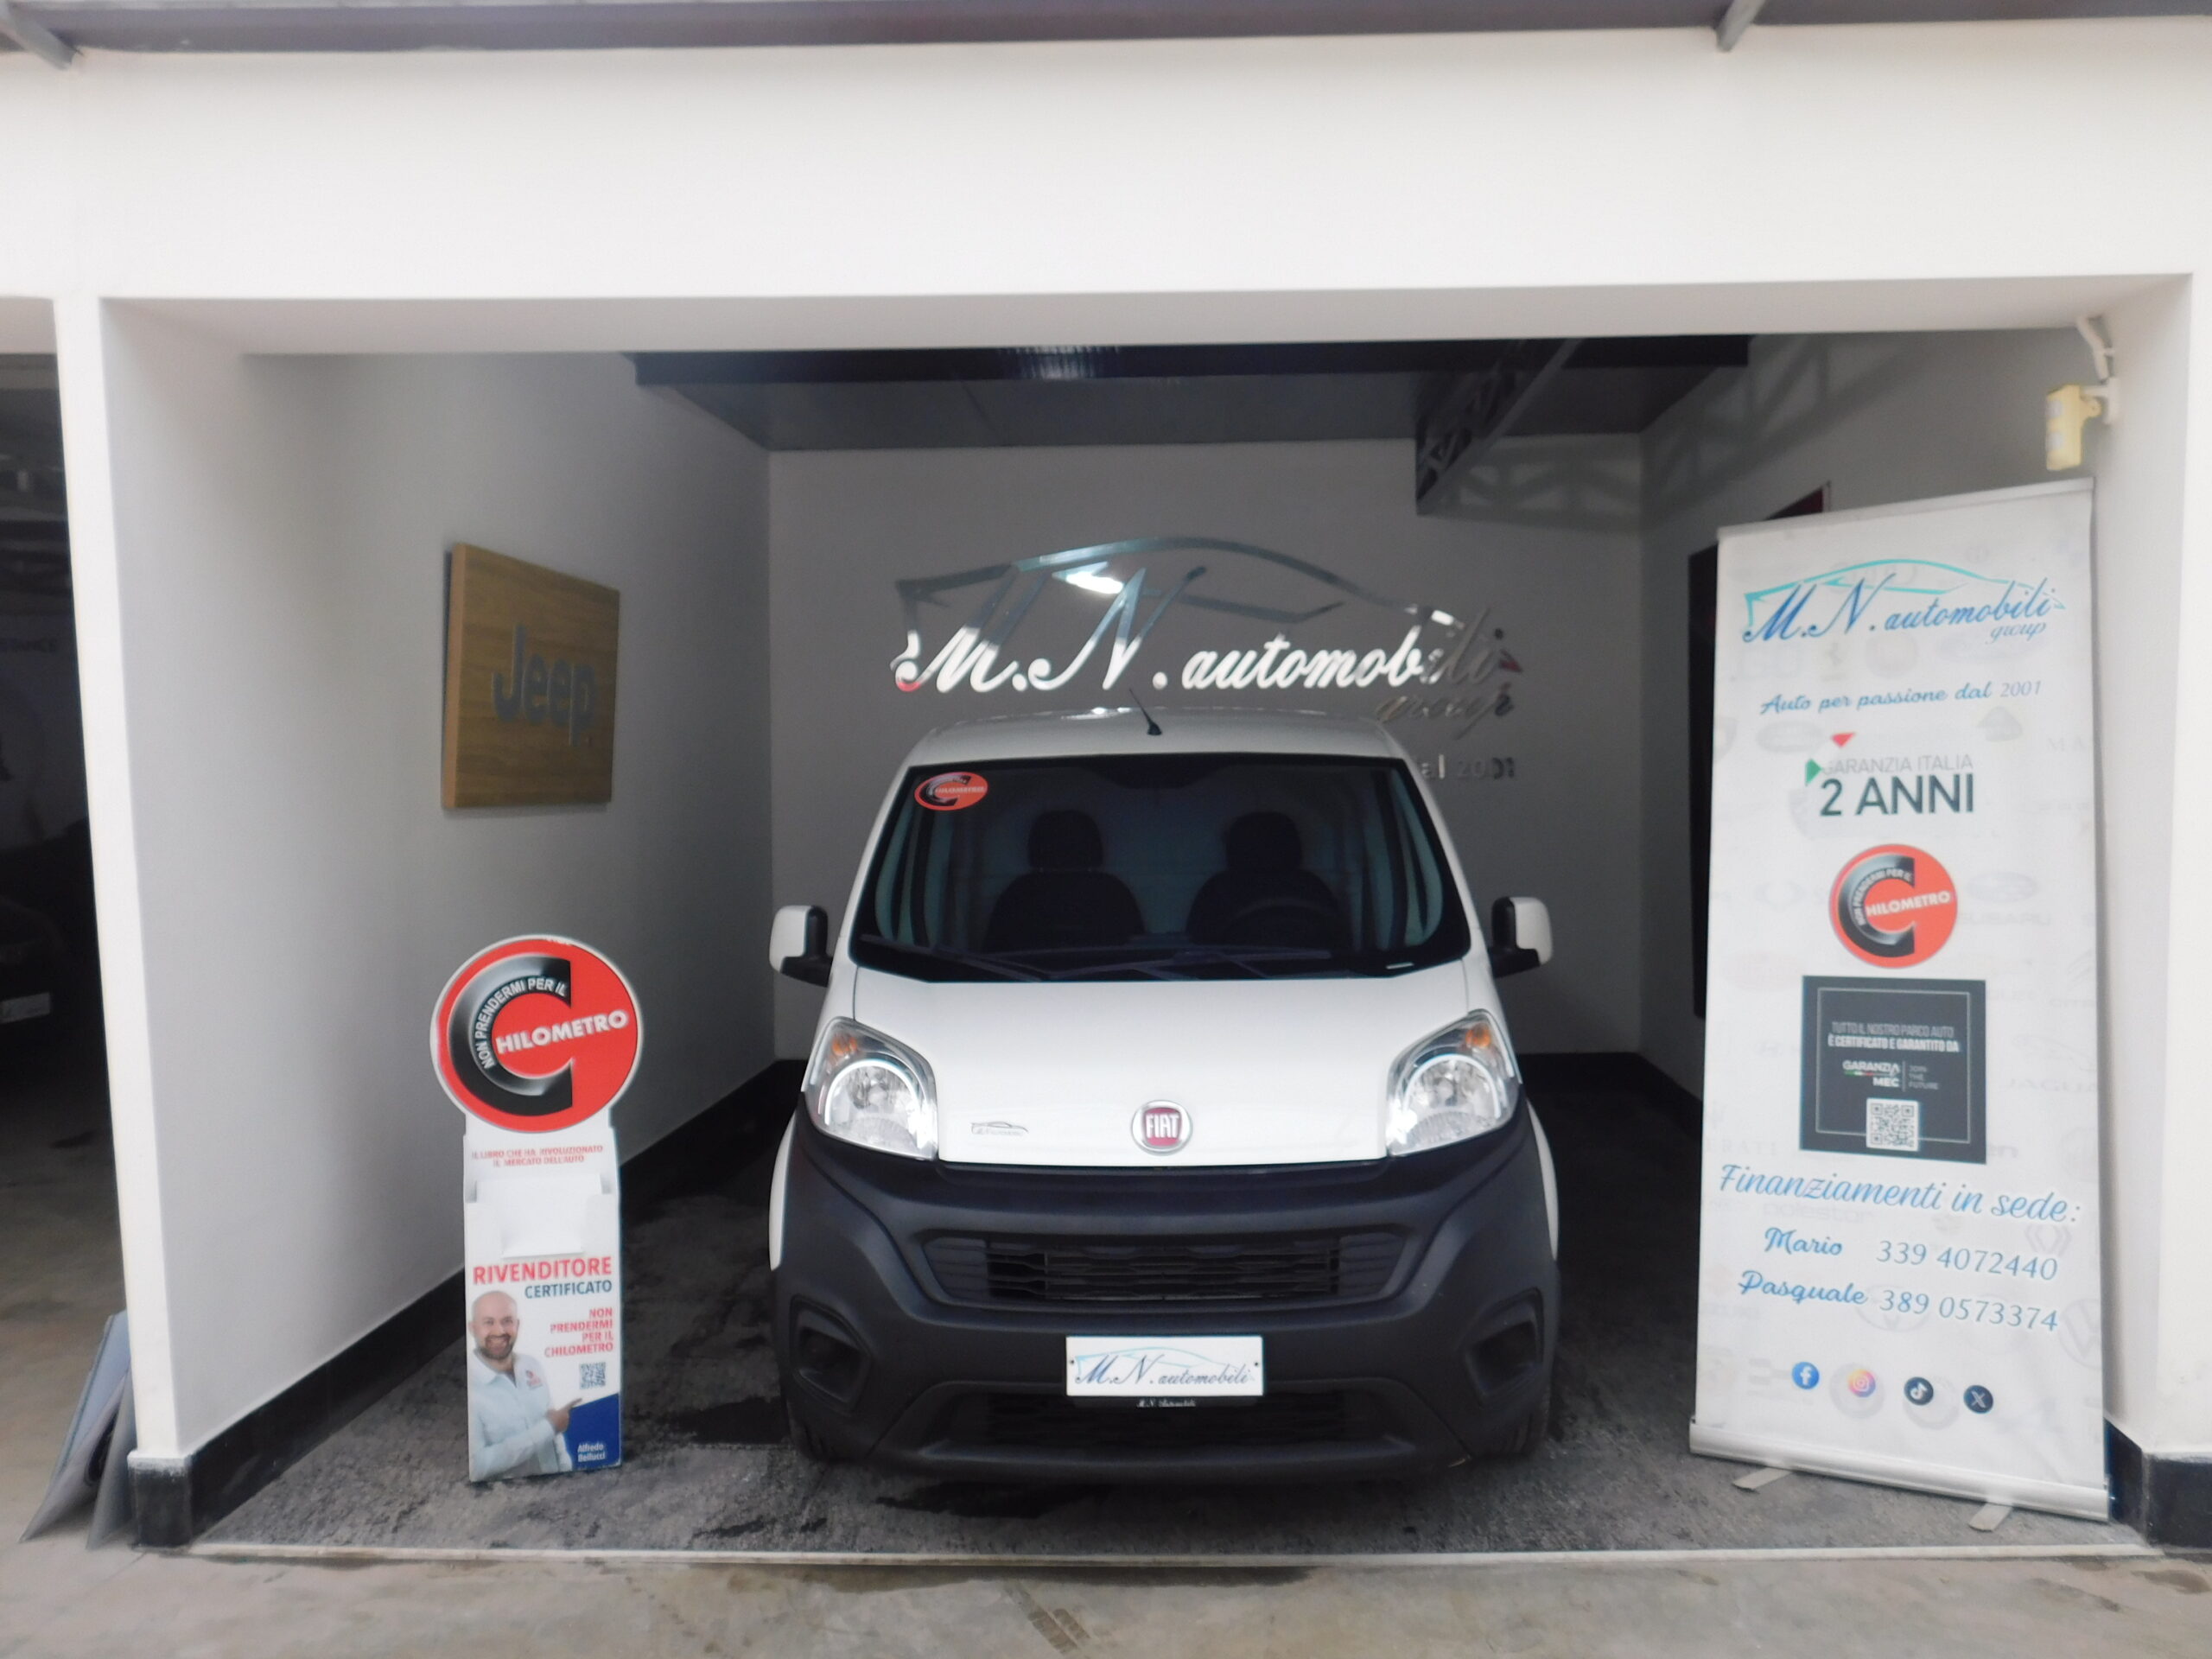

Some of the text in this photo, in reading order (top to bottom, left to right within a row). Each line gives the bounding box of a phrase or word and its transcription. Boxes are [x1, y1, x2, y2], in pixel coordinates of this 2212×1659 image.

[1885, 577, 2056, 632] automobili
[1985, 620, 2046, 645] group
[491, 623, 598, 748] Jeep
[1760, 679, 2042, 715] Auto per passione dal 2001
[1822, 753, 1974, 775] GARANZIA ITALIA
[1819, 773, 1974, 817] 2 ANNI
[474, 977, 567, 1070] NON PRENDERMI PER IL
[1867, 1023, 1900, 1035] NOSTRO
[1902, 1025, 1930, 1037] PARCO
[1931, 1026, 1955, 1038] AUTO
[1835, 1035, 1888, 1049] CERTIFICATO
[1890, 1037, 1896, 1049] E
[1897, 1039, 1945, 1052] GARANTITO
[1946, 1040, 1960, 1052] DA
[1842, 1060, 1900, 1075] GARANZIA
[1872, 1077, 1900, 1088] MEC
[1146, 1113, 1179, 1139] FIAT
[480, 1150, 505, 1159] LIBRO
[506, 1149, 524, 1158] CHE
[524, 1148, 537, 1157] HA
[539, 1145, 604, 1155] RIVOLUZIONATO
[504, 1157, 542, 1166] MERCATO
[1719, 1164, 2082, 1224] Finanziamenti in sede:
[1763, 1227, 2059, 1281] Mario 339 4072440
[473, 1256, 613, 1286] RIVENDITORE
[524, 1280, 613, 1299] CERTIFICATO
[1738, 1269, 2059, 1332] Pasquale 389 0573374
[589, 1306, 613, 1319] NON
[550, 1319, 613, 1334] PRENDERMI
[582, 1331, 614, 1342] PER IL
[544, 1342, 613, 1358] CHILOMETRO
[1158, 1363, 1252, 1385] automobili
[577, 1442, 605, 1453] Alfredo
